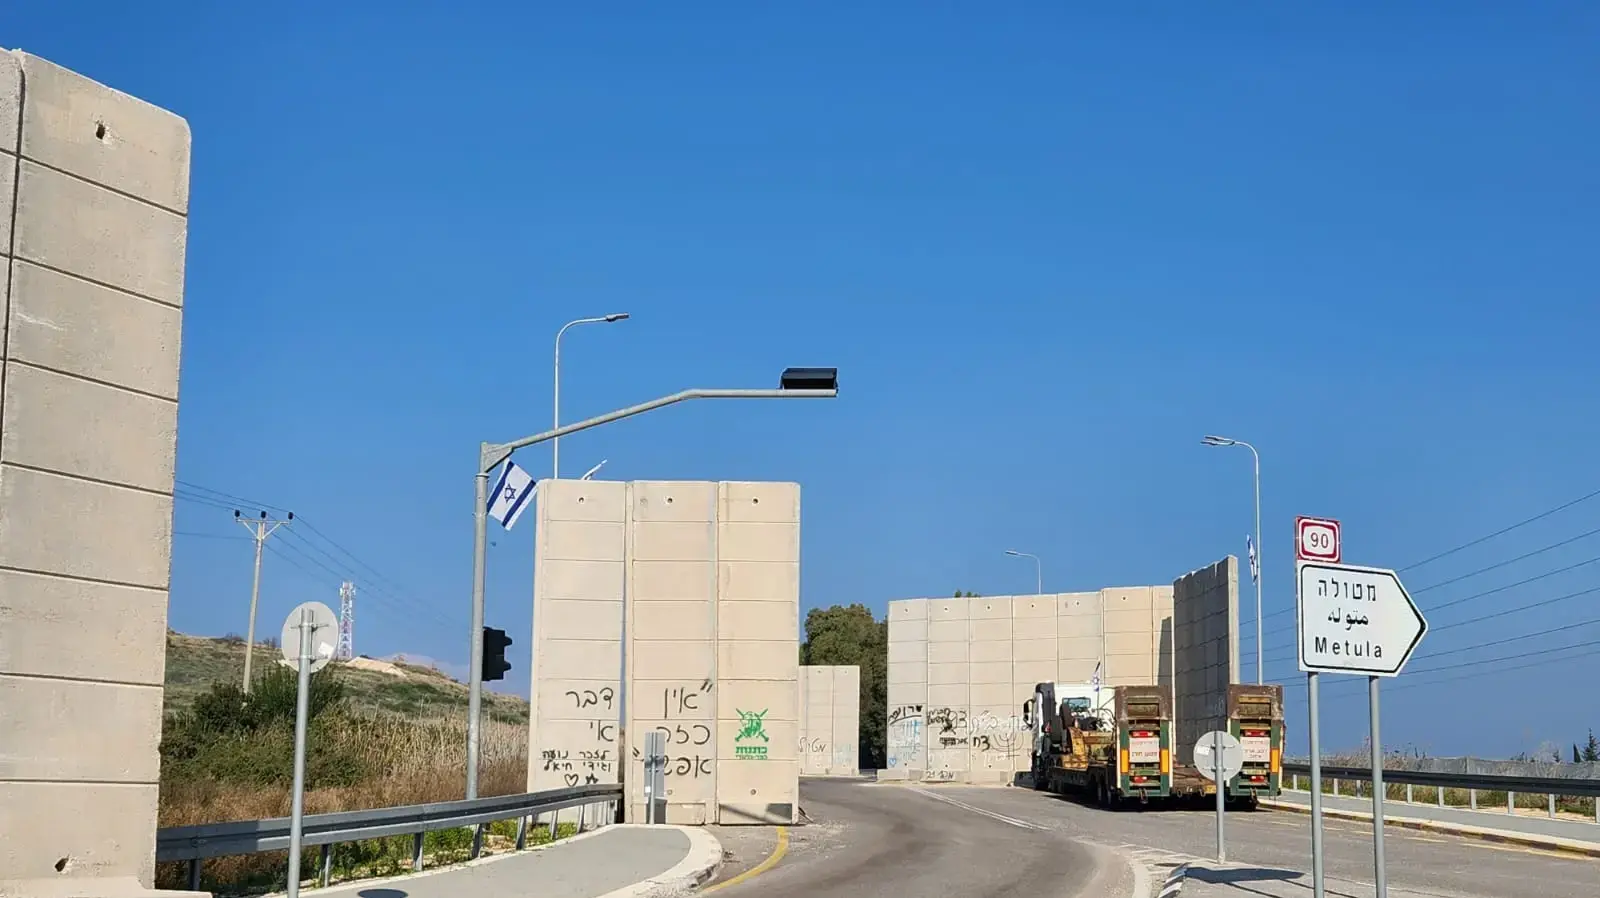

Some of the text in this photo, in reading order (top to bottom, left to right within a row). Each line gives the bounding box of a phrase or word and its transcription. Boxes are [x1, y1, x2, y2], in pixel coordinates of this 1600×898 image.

[1310, 532, 1329, 549] 90
[1318, 577, 1376, 601] מטולה
[1315, 636, 1382, 658] Metula
[565, 686, 614, 710] דבר
[590, 719, 614, 742] אי
